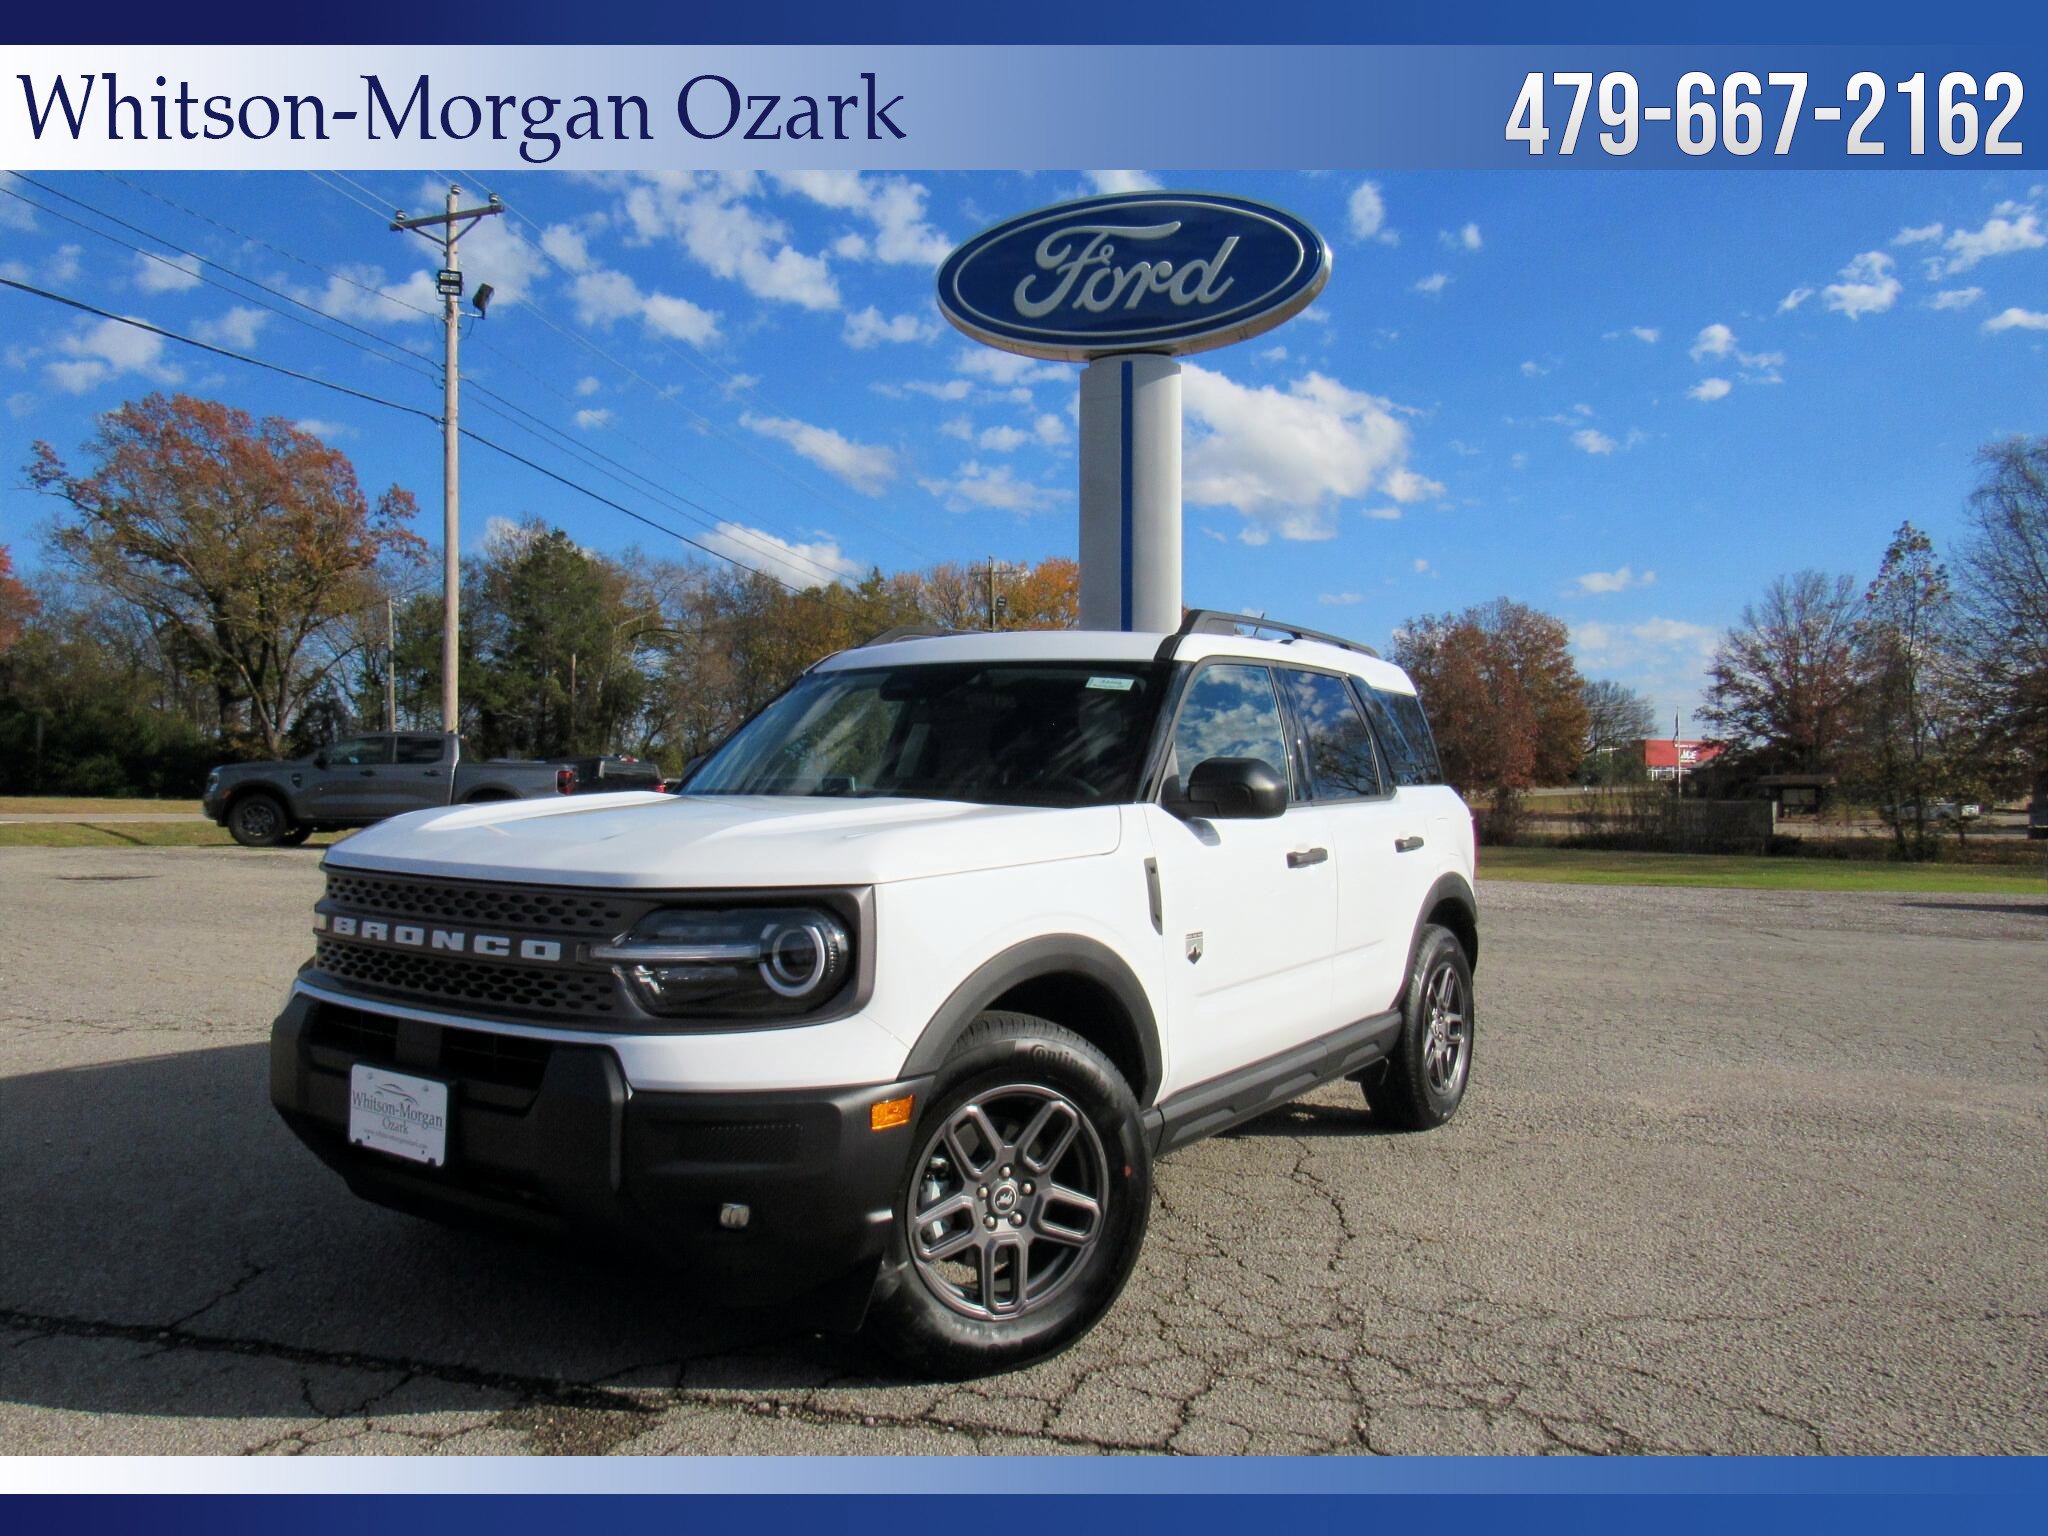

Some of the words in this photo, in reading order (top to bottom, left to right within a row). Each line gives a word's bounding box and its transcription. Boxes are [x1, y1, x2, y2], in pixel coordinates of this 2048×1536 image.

[1013, 220, 1240, 319] Ford
[333, 915, 561, 962] BRONCO
[352, 1090, 443, 1130] Whitson-Morgan
[382, 1116, 409, 1135] Ozark
